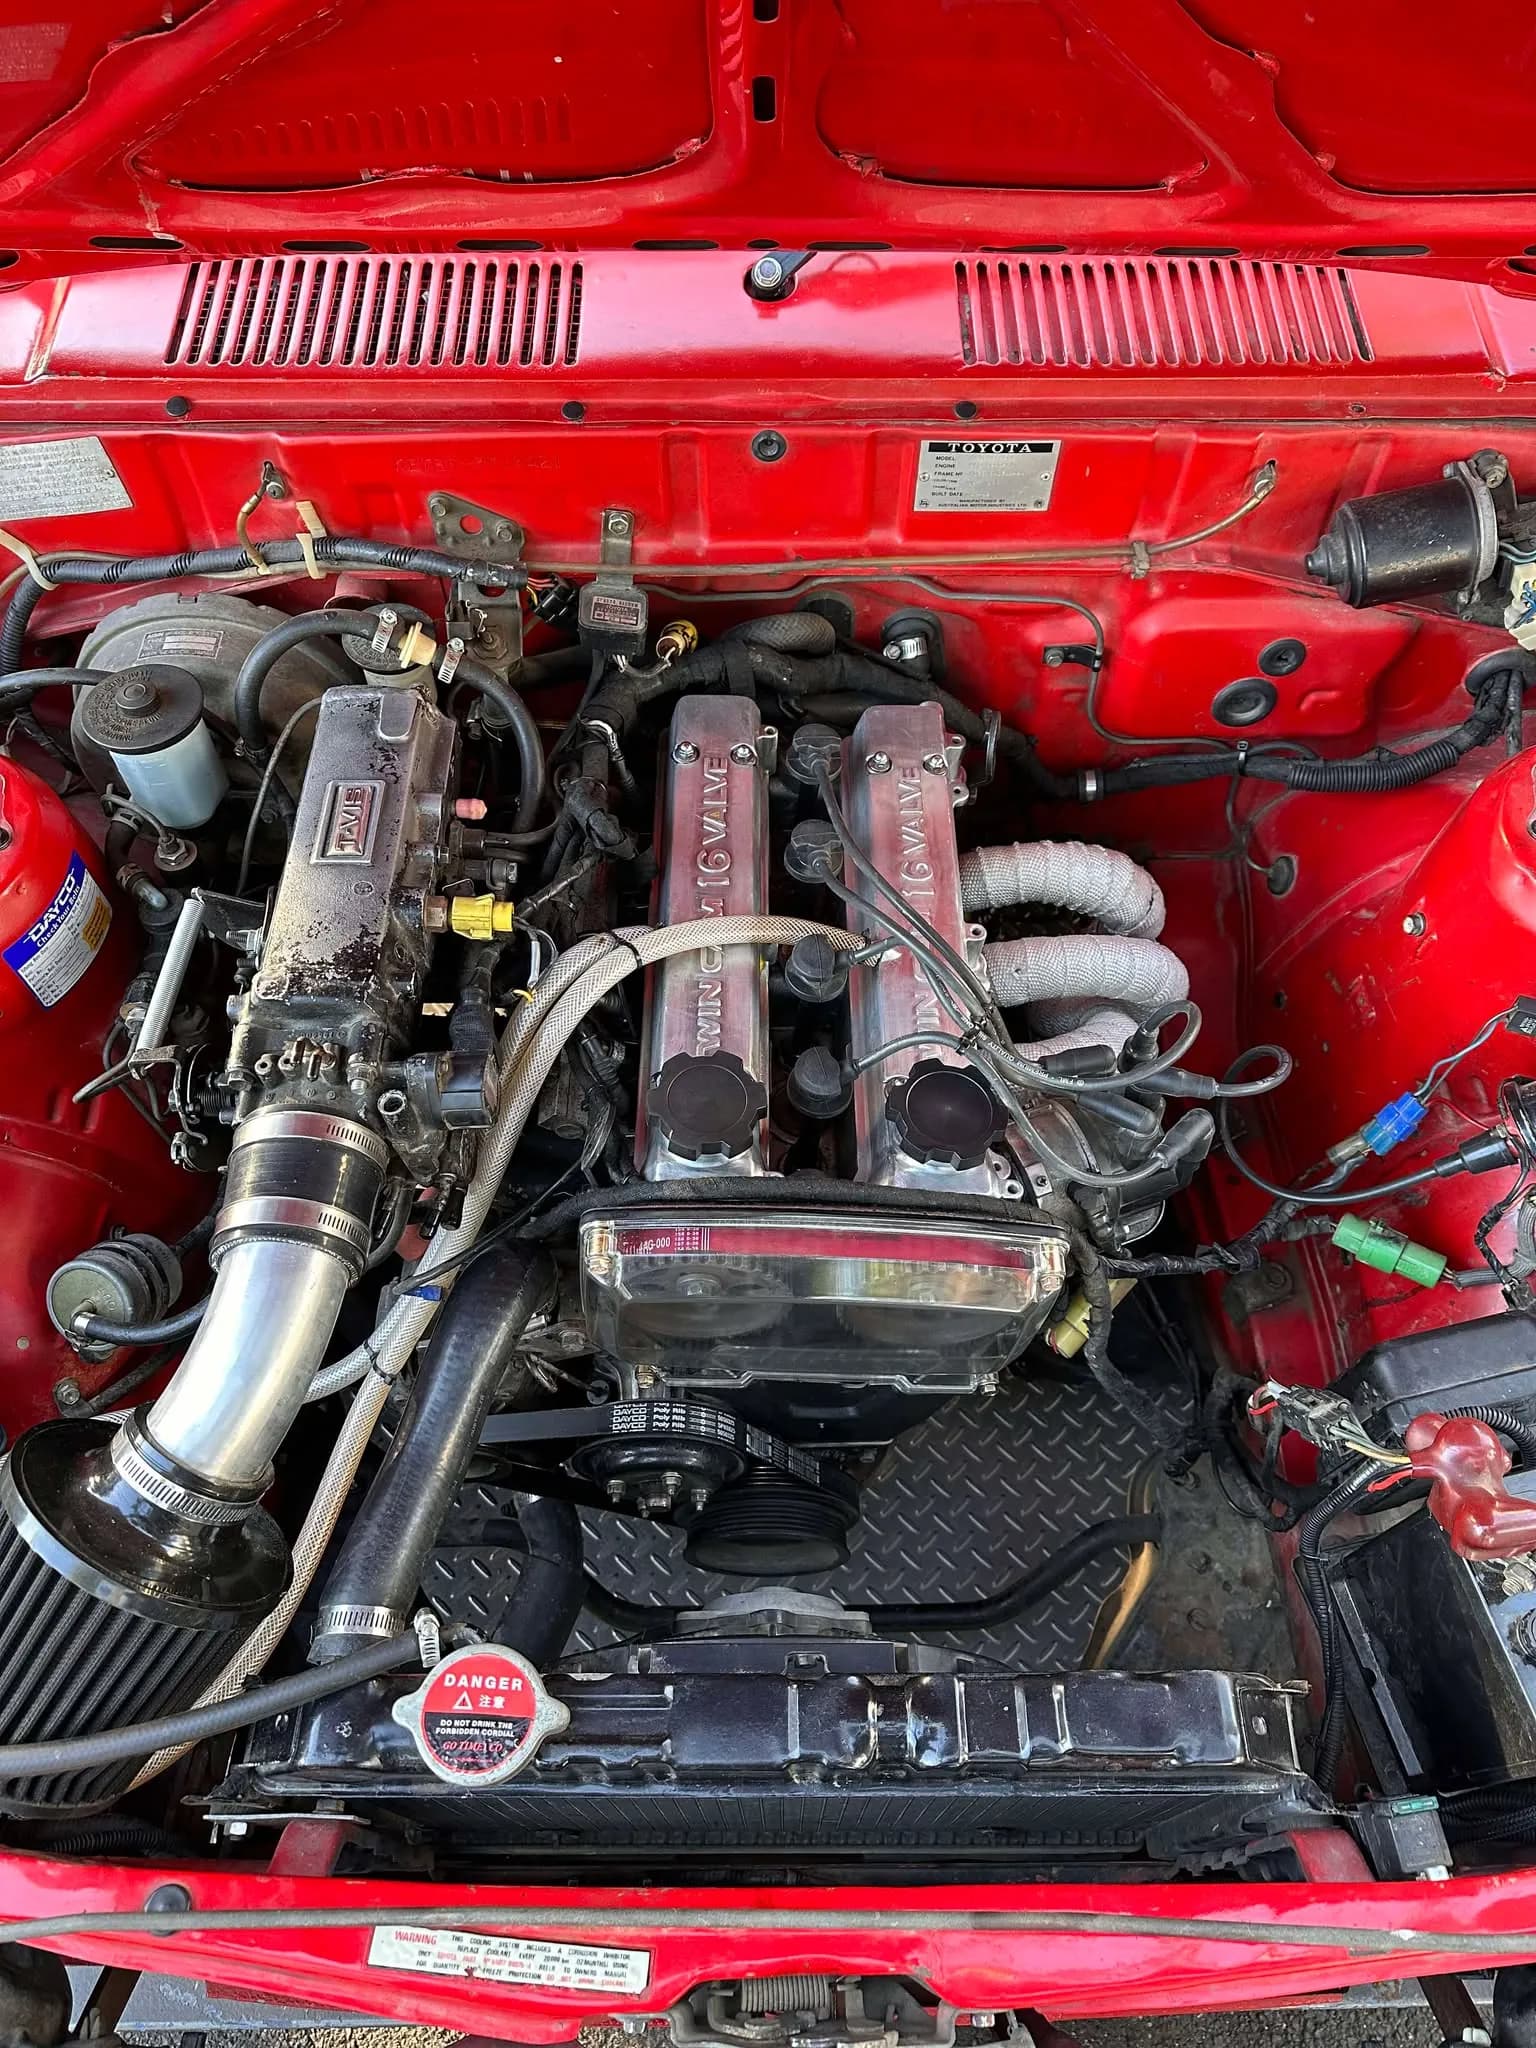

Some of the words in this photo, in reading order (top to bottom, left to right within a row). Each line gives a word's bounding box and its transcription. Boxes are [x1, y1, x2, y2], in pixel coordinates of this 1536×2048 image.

[948, 443, 1032, 453] TOYOTA
[702, 757, 728, 847] VALVE
[898, 766, 926, 855] VALVE
[697, 848, 731, 888] 16
[900, 861, 935, 897] 16
[25, 870, 76, 943] DAYCO
[36, 922, 60, 948] Check
[56, 905, 71, 925] Your
[69, 886, 81, 908] Belts
[987, 1041, 1015, 1062] QUALITY
[613, 1407, 647, 1416] DAYCO
[613, 1414, 647, 1423] DAYCO
[612, 1422, 646, 1430] DAYCO
[443, 1674, 523, 1691] DANGER
[479, 1694, 505, 1709] 注意
[435, 1727, 480, 1736] FORBIDDEN
[481, 1729, 515, 1738] CORDIAL
[440, 1719, 453, 1727] DO
[453, 1720, 470, 1728] NOT
[471, 1721, 496, 1729] DRINK
[497, 1722, 513, 1730] THE
[394, 1930, 437, 1945] WARNING
[470, 1937, 492, 1946] COOLING
[498, 1941, 520, 1949] SYSTEM
[603, 1951, 631, 1960] INHIBITOR
[457, 1945, 480, 1954] REPLACE
[486, 1948, 511, 1957] COOLANT
[519, 1952, 536, 1960] EVERY
[433, 1962, 460, 1970] QUANTITY
[508, 1970, 542, 1979] PROTECTION
[604, 1970, 627, 1978] MANUAL
